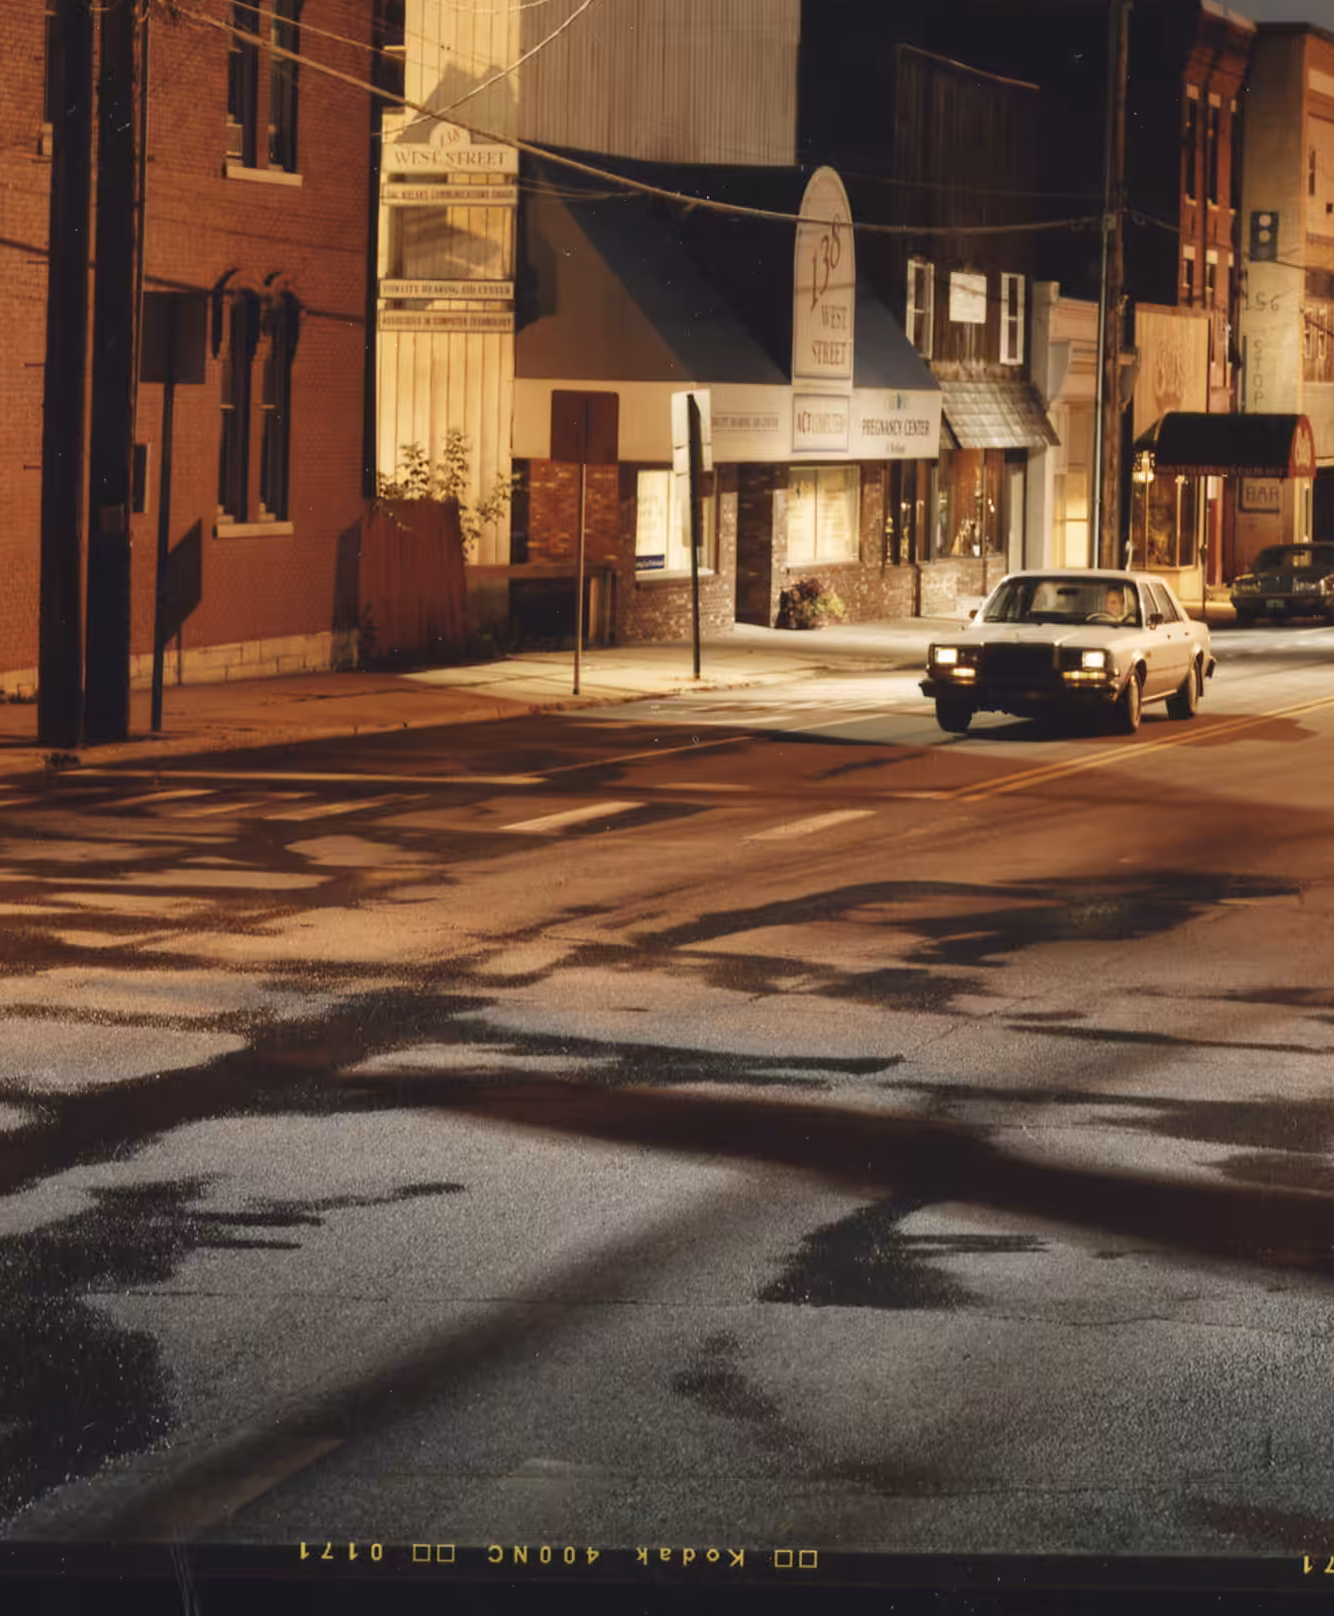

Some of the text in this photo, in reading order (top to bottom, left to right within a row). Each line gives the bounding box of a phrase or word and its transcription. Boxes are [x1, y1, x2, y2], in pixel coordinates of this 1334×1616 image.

[395, 151, 507, 166] WEST STREET
[810, 212, 841, 313] 138
[821, 303, 848, 330] WEST
[812, 339, 848, 366] STREET
[904, 418, 930, 437] CENTER
[299, 1542, 744, 1566] Kodak 400NC 0171
